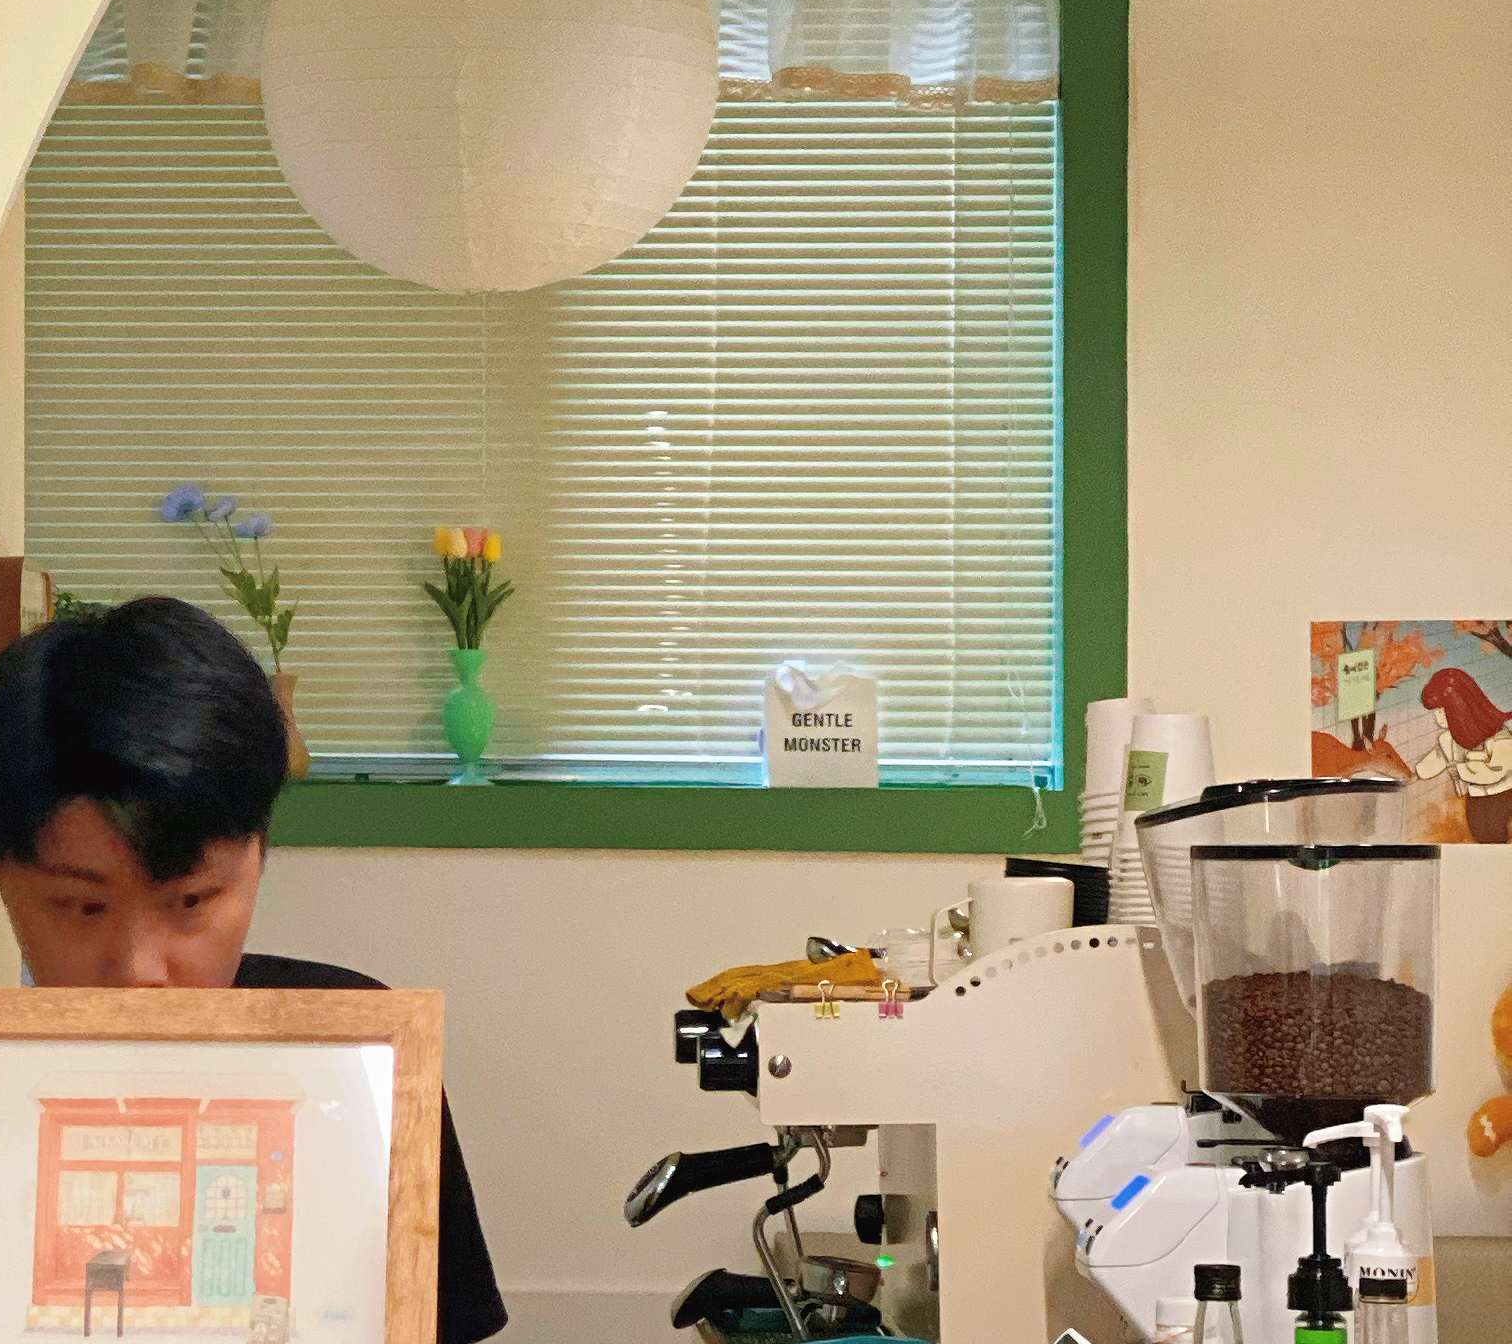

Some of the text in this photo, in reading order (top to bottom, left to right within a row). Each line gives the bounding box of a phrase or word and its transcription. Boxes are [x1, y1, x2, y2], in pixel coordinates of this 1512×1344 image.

[791, 713, 853, 727] GENTLE
[784, 737, 862, 753] MONSTER
[1359, 1266, 1415, 1278] MONIN
